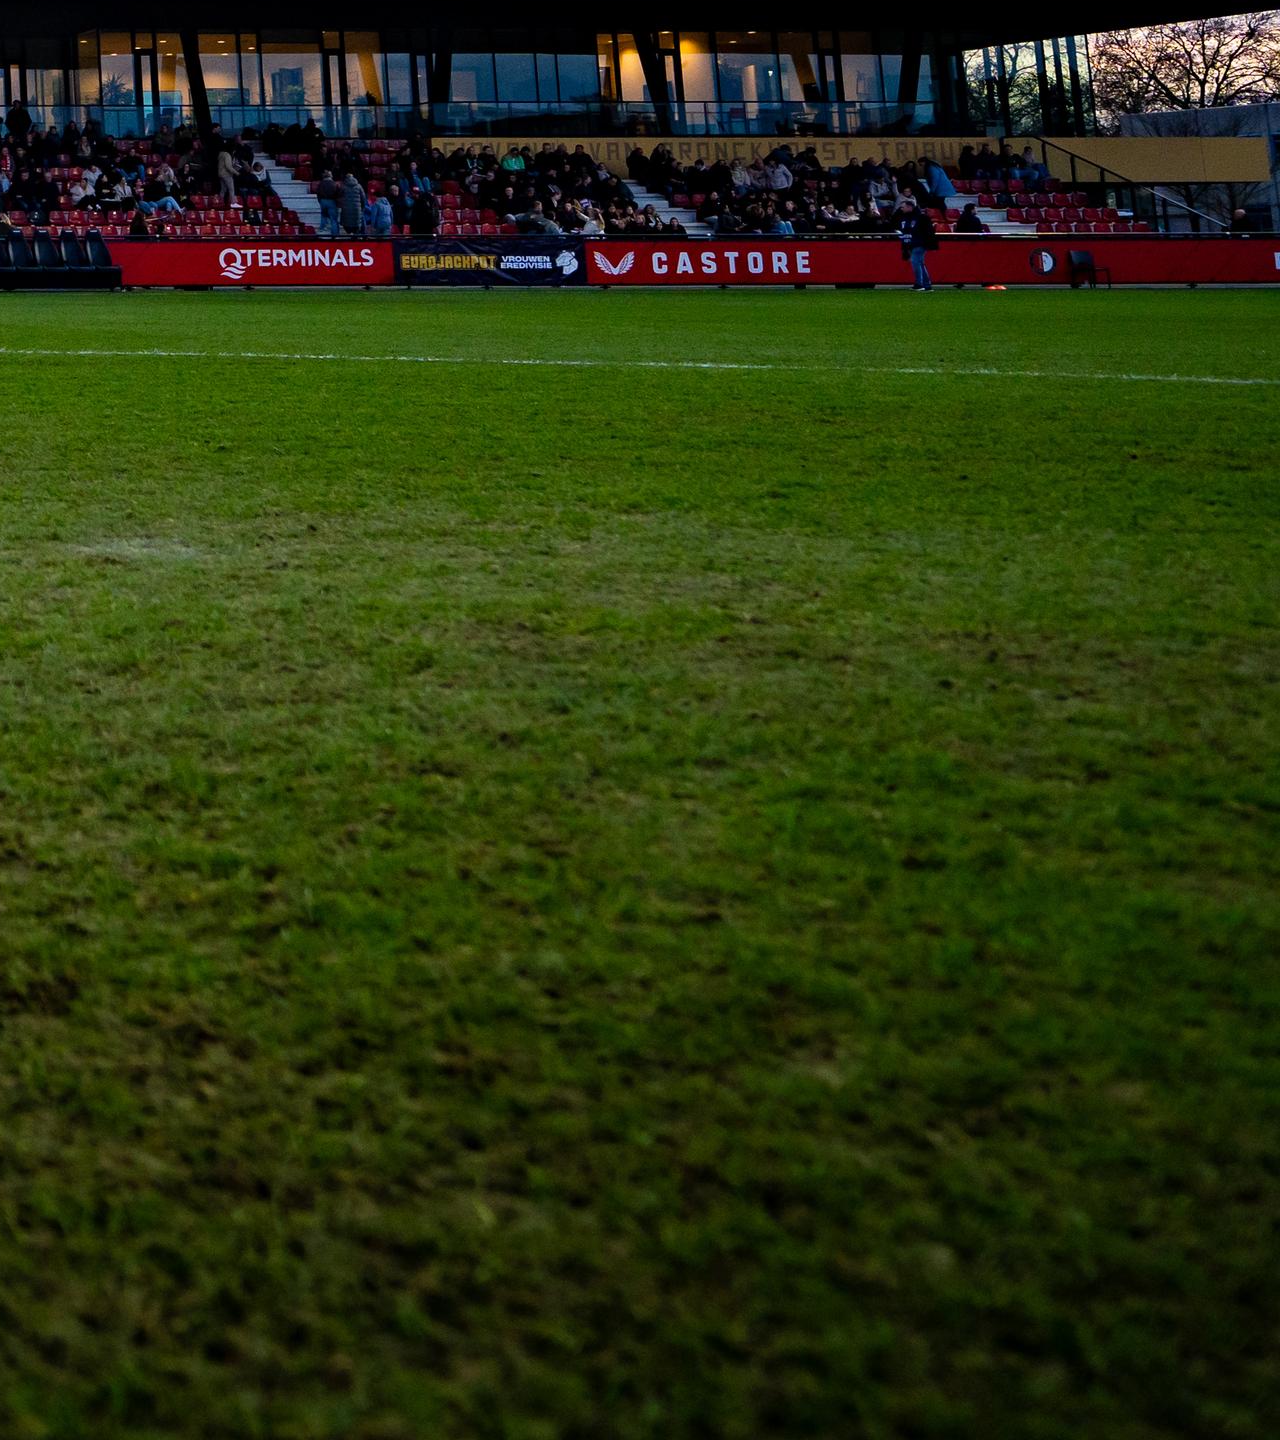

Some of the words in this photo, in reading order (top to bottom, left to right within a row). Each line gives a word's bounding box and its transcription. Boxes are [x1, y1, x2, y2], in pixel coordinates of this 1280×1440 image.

[219, 248, 374, 279] QTERMINALS
[401, 254, 498, 270] EUROJACKPOT
[652, 251, 811, 274] CASTORE
